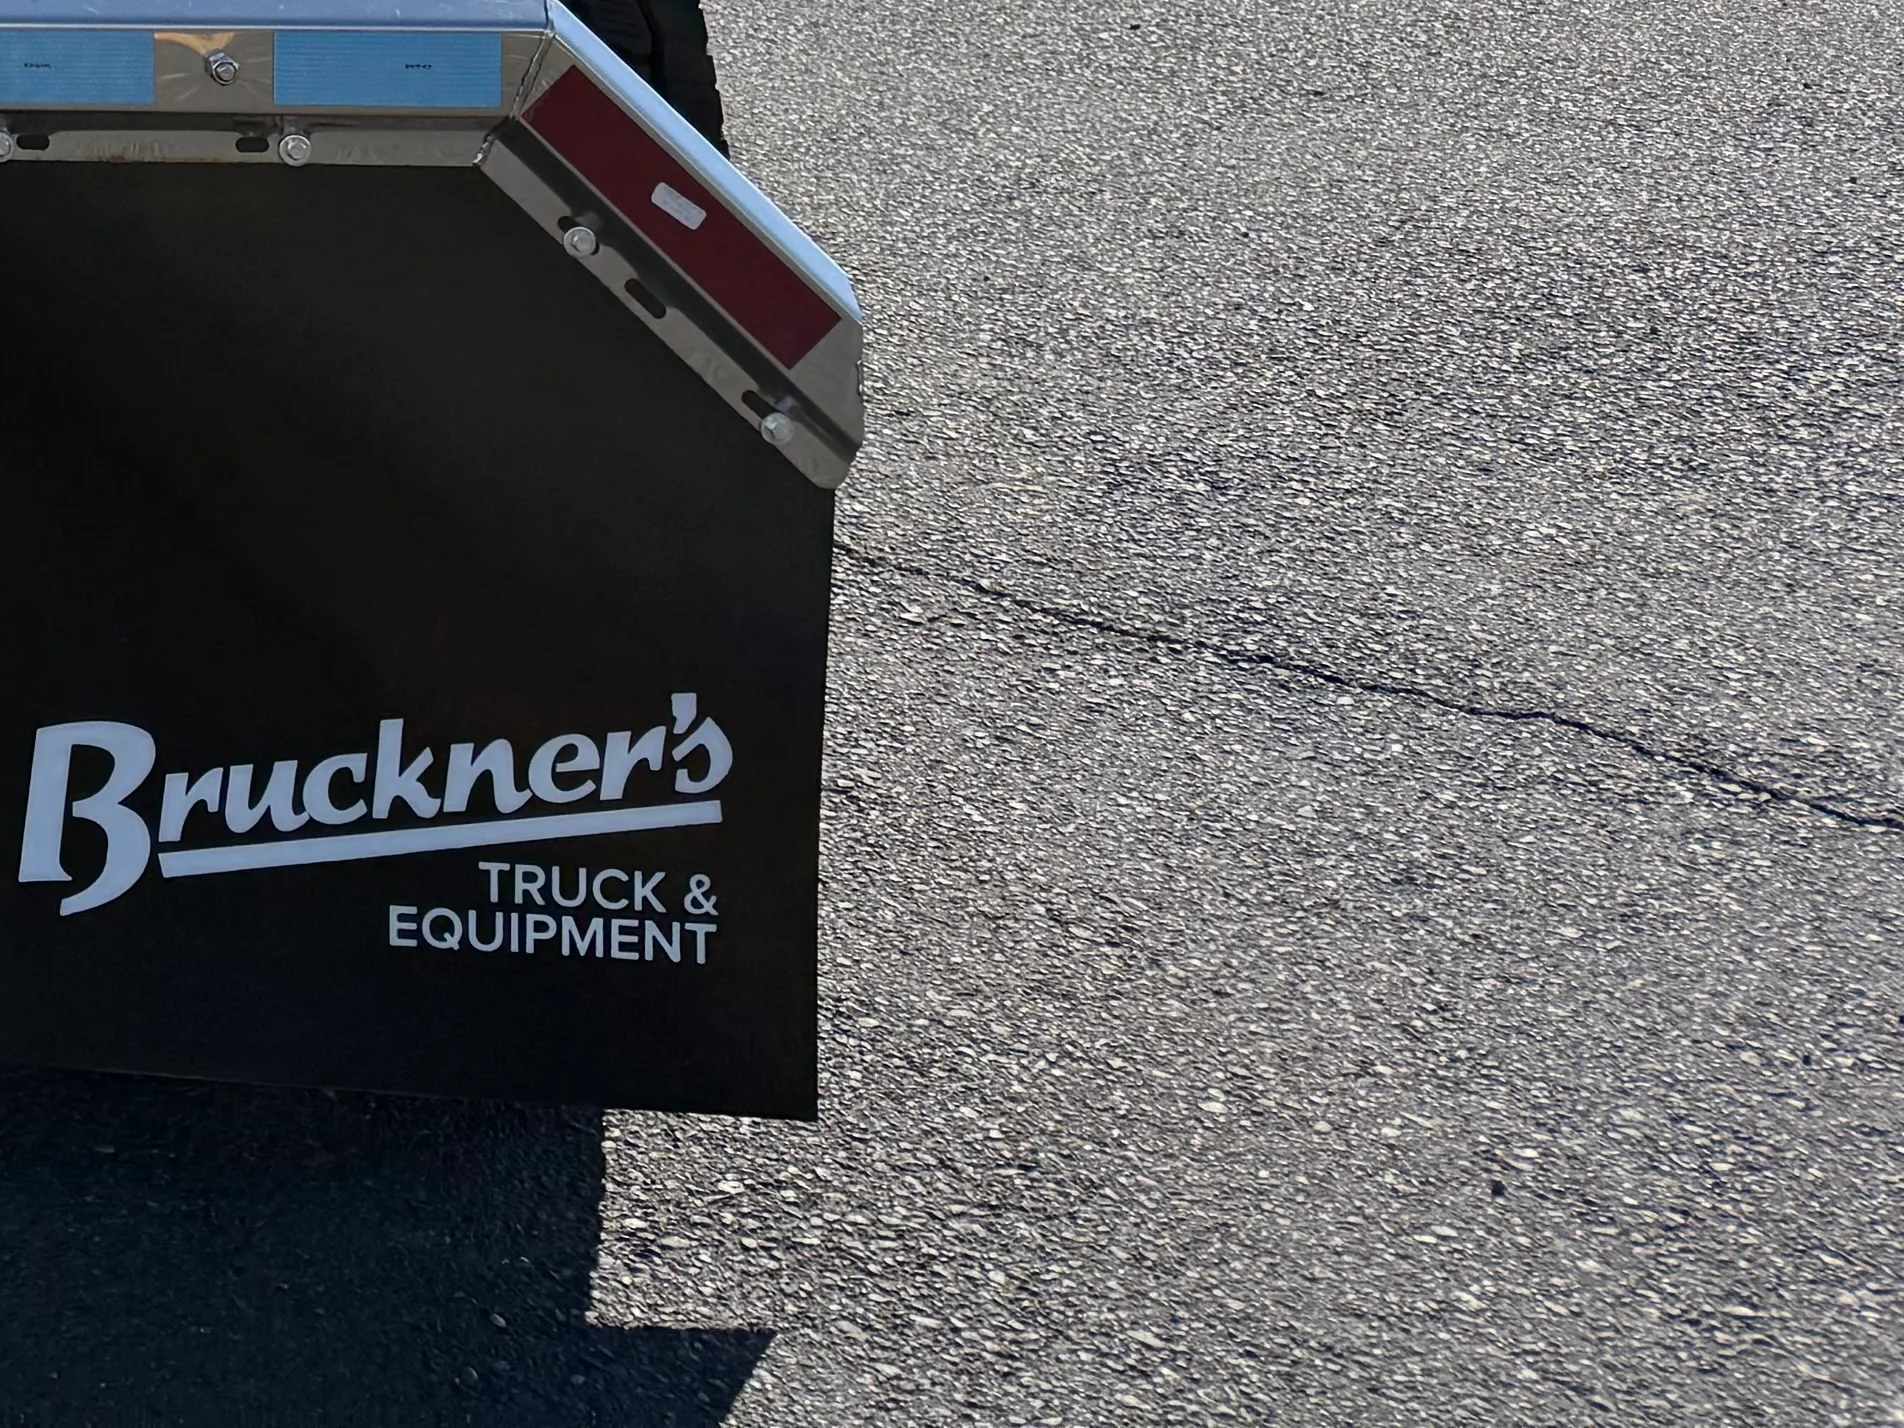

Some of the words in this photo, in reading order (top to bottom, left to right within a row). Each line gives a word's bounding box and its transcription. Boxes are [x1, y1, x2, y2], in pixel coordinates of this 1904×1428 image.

[17, 692, 734, 917] Bruckner's
[478, 861, 667, 913] TRUCK
[684, 873, 719, 916] &
[388, 905, 718, 965] EQUIPMENT
